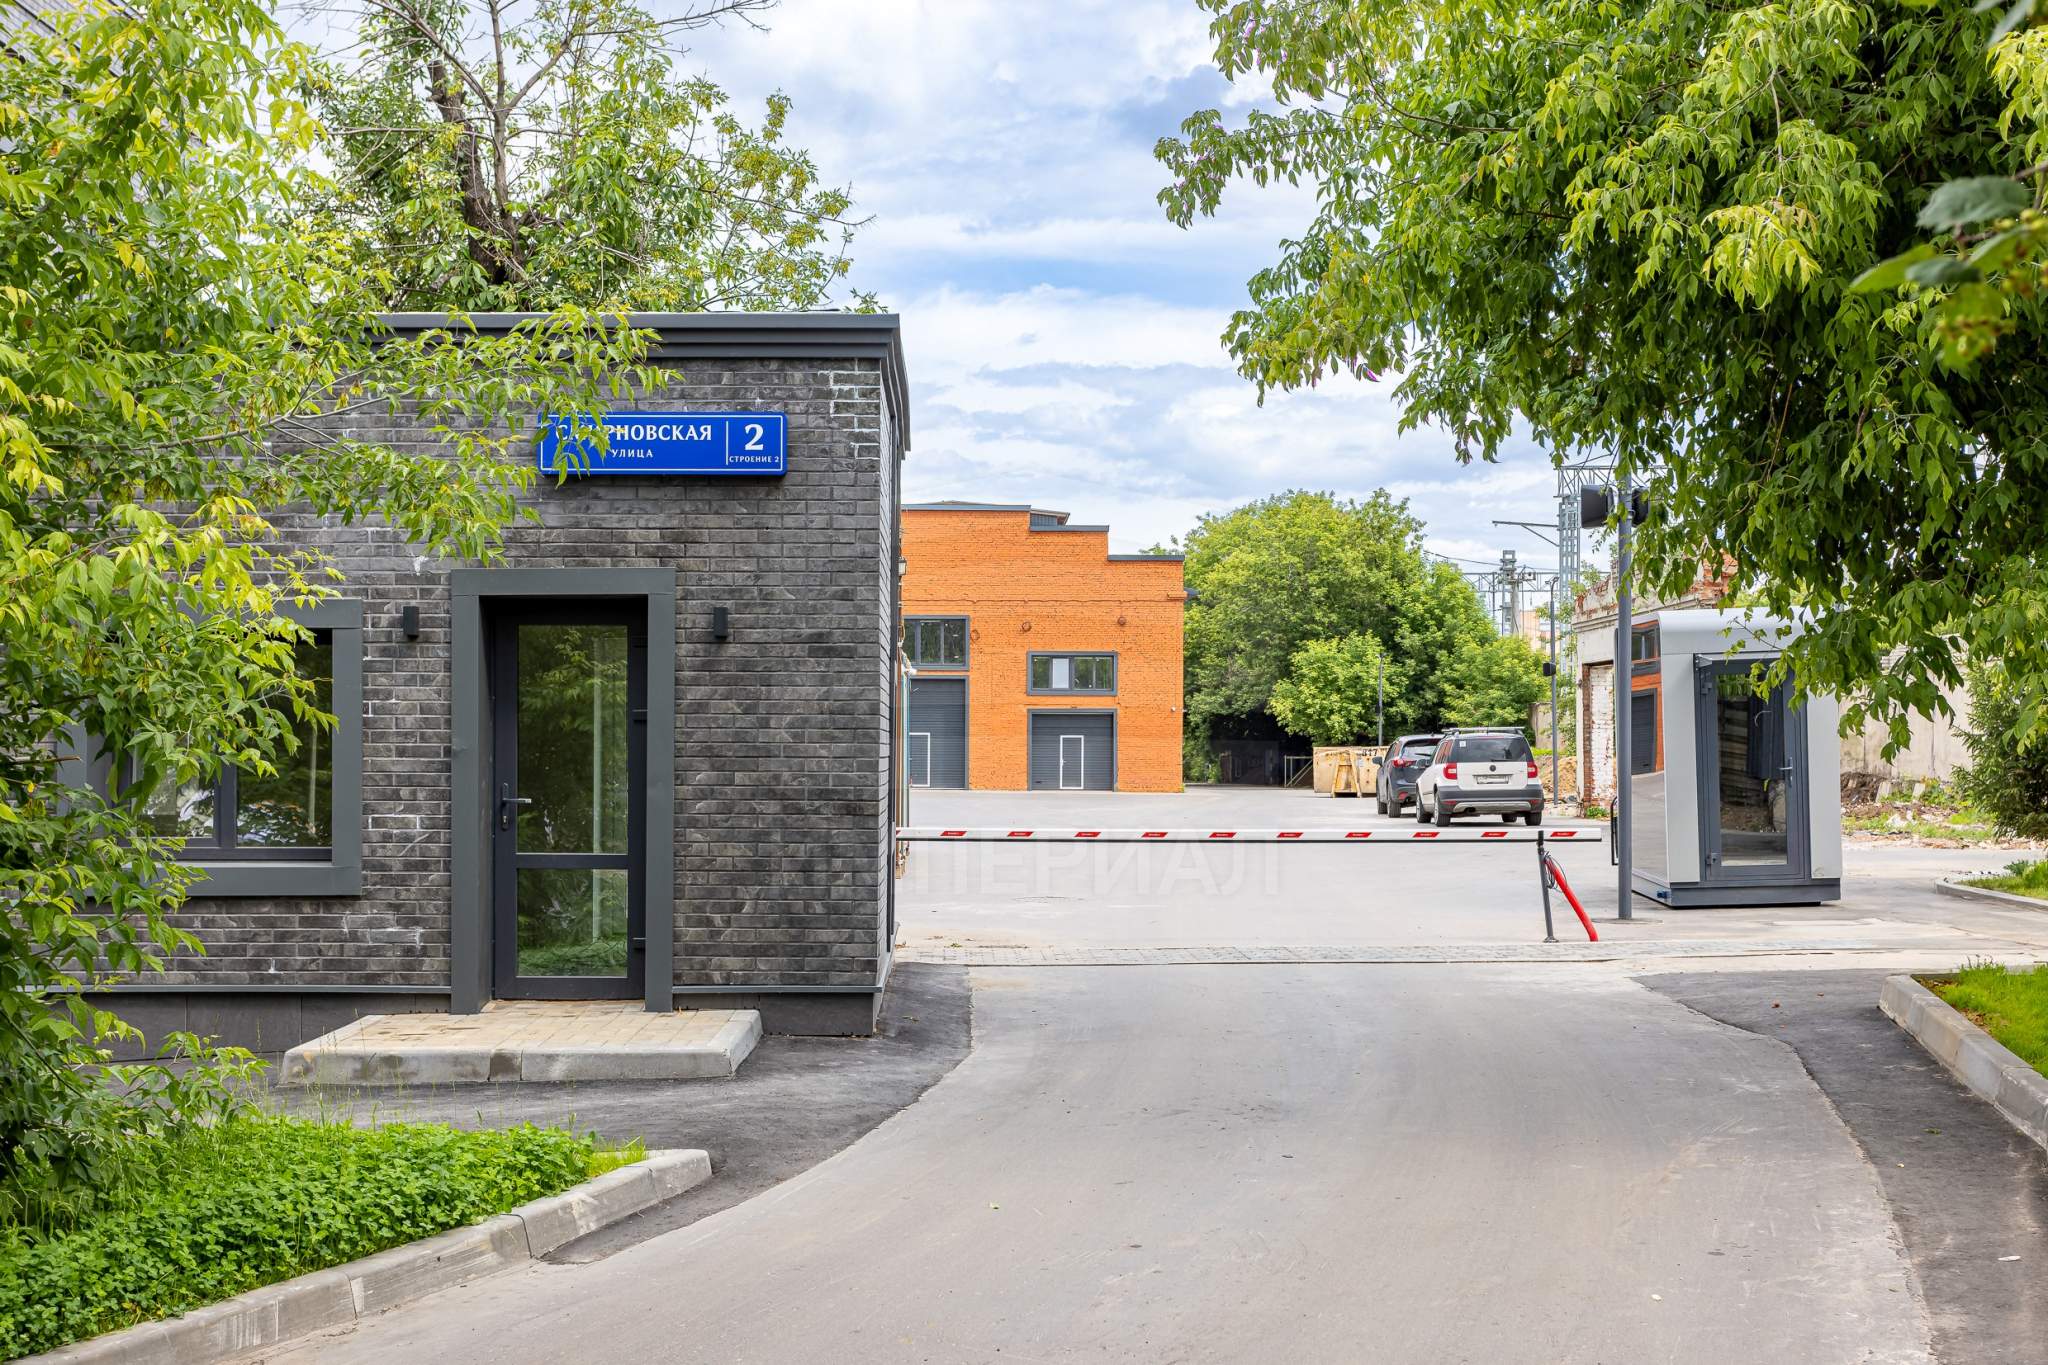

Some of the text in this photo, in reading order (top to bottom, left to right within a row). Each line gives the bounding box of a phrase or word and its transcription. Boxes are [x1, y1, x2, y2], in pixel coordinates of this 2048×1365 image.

[556, 424, 712, 441] СРНОВСКАЯ
[745, 423, 764, 451] 2
[611, 449, 653, 459] УЛИЦА
